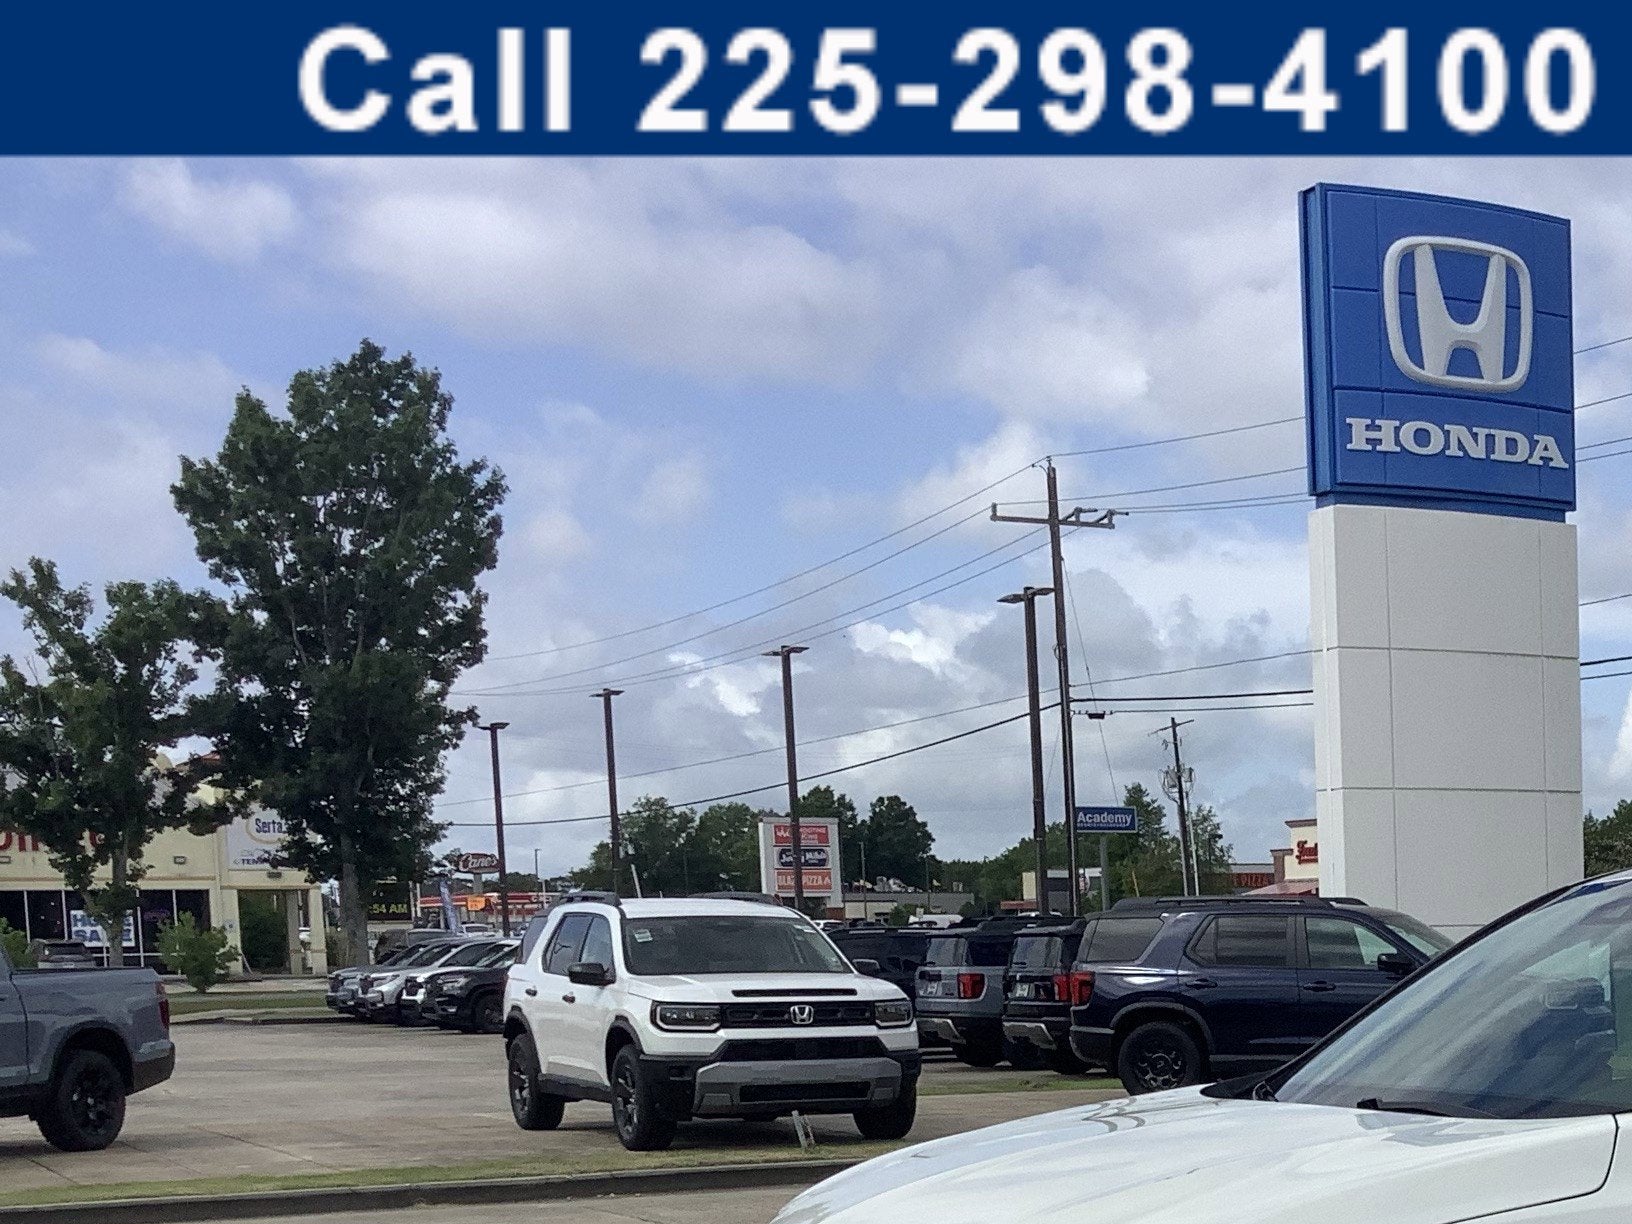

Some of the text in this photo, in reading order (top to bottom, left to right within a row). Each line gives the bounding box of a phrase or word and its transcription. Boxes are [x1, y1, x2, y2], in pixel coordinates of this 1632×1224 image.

[1346, 417, 1569, 469] HONDA
[255, 818, 282, 833] Serta
[1077, 811, 1132, 826] Academy
[389, 904, 408, 914] AM
